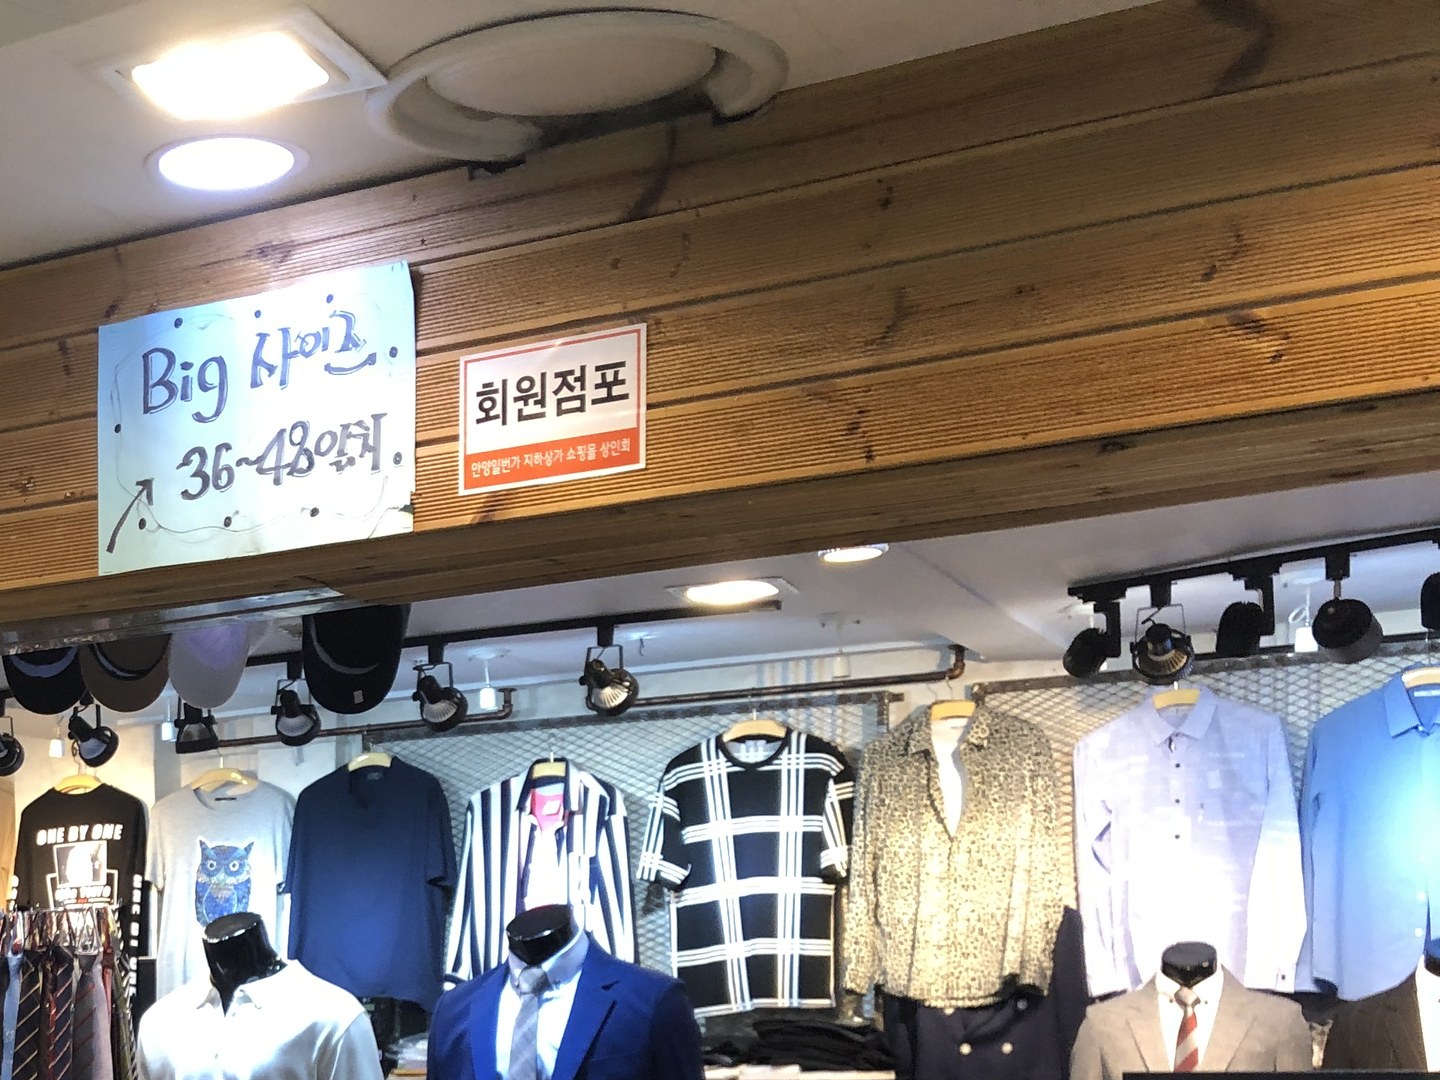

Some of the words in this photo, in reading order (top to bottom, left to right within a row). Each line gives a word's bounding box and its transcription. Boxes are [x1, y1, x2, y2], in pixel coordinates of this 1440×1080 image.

[142, 347, 228, 423] Big
[250, 309, 377, 390] 사이즈
[475, 361, 630, 427] 회원점포
[471, 455, 521, 479] 안양일번가
[523, 449, 564, 467] 지하상가
[566, 443, 597, 462] 쇼핑몰
[599, 437, 631, 457] 상인회
